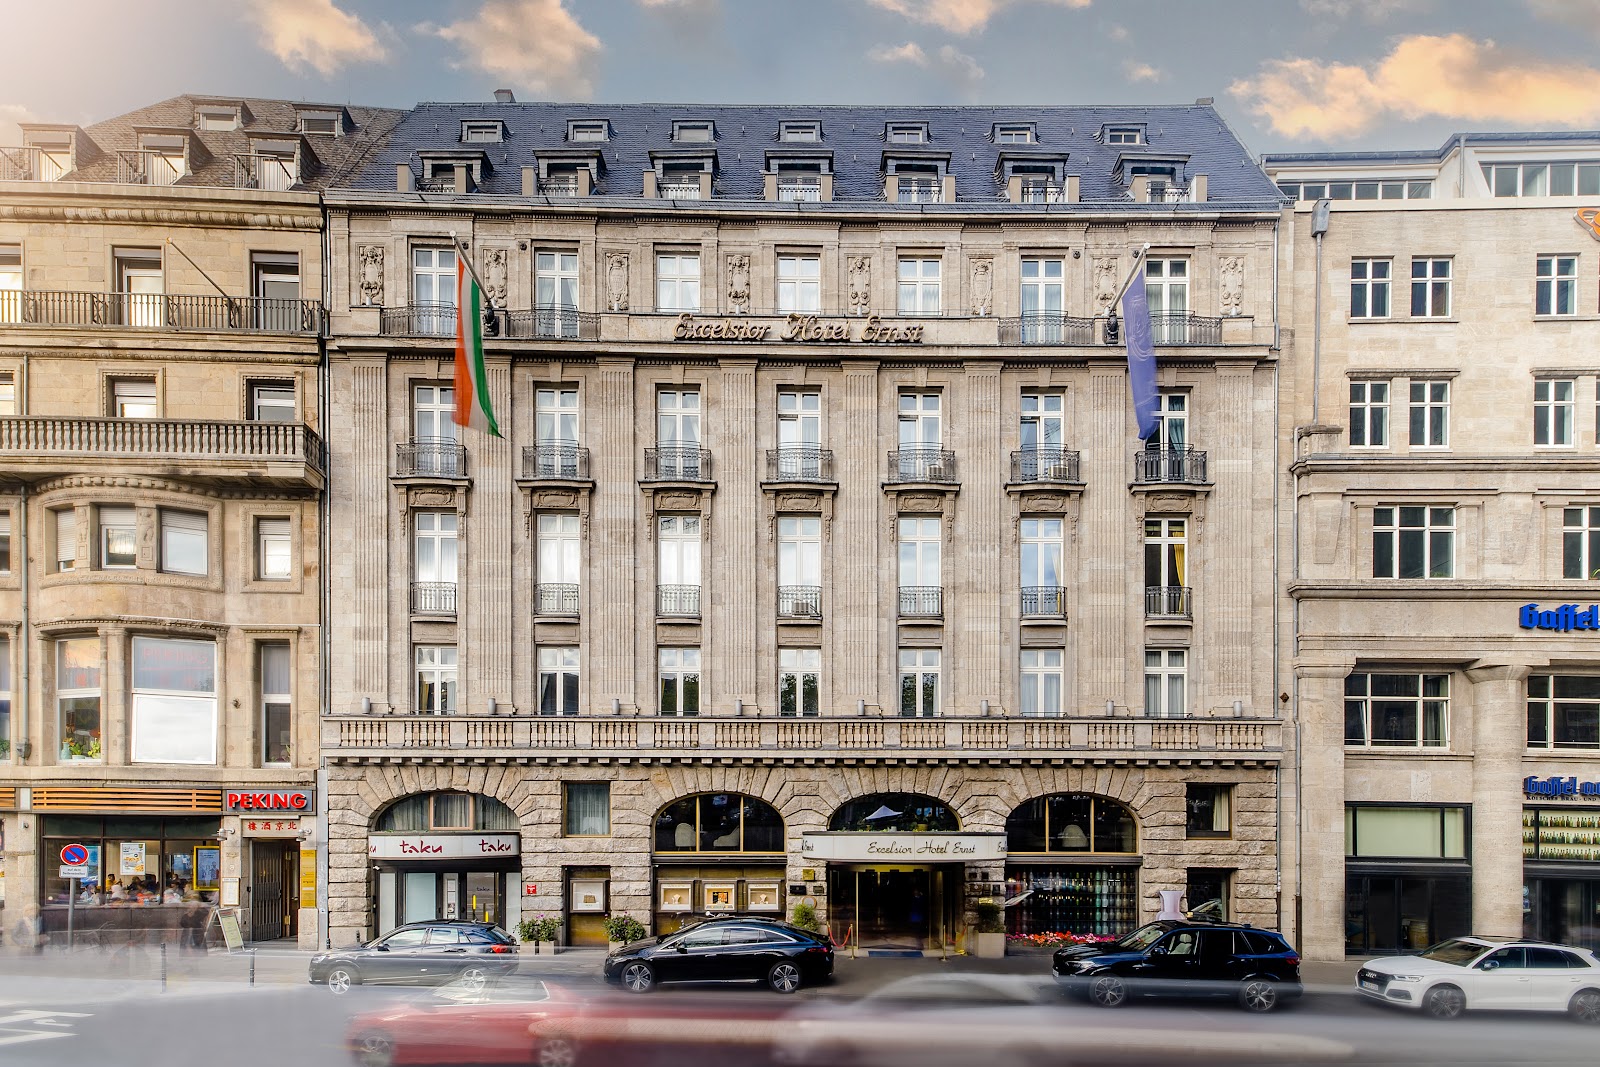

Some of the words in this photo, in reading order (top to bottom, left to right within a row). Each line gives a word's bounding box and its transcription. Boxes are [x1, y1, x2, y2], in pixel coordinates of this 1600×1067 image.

[673, 313, 771, 341] Excelsior
[780, 313, 851, 342] Hotel
[861, 315, 923, 343] Ernst
[227, 792, 307, 809] PEKING
[399, 840, 443, 854] taku
[479, 839, 512, 853] taku
[867, 841, 912, 854] Excelsior
[916, 838, 950, 854] Hotel
[952, 841, 976, 854] Ernst
